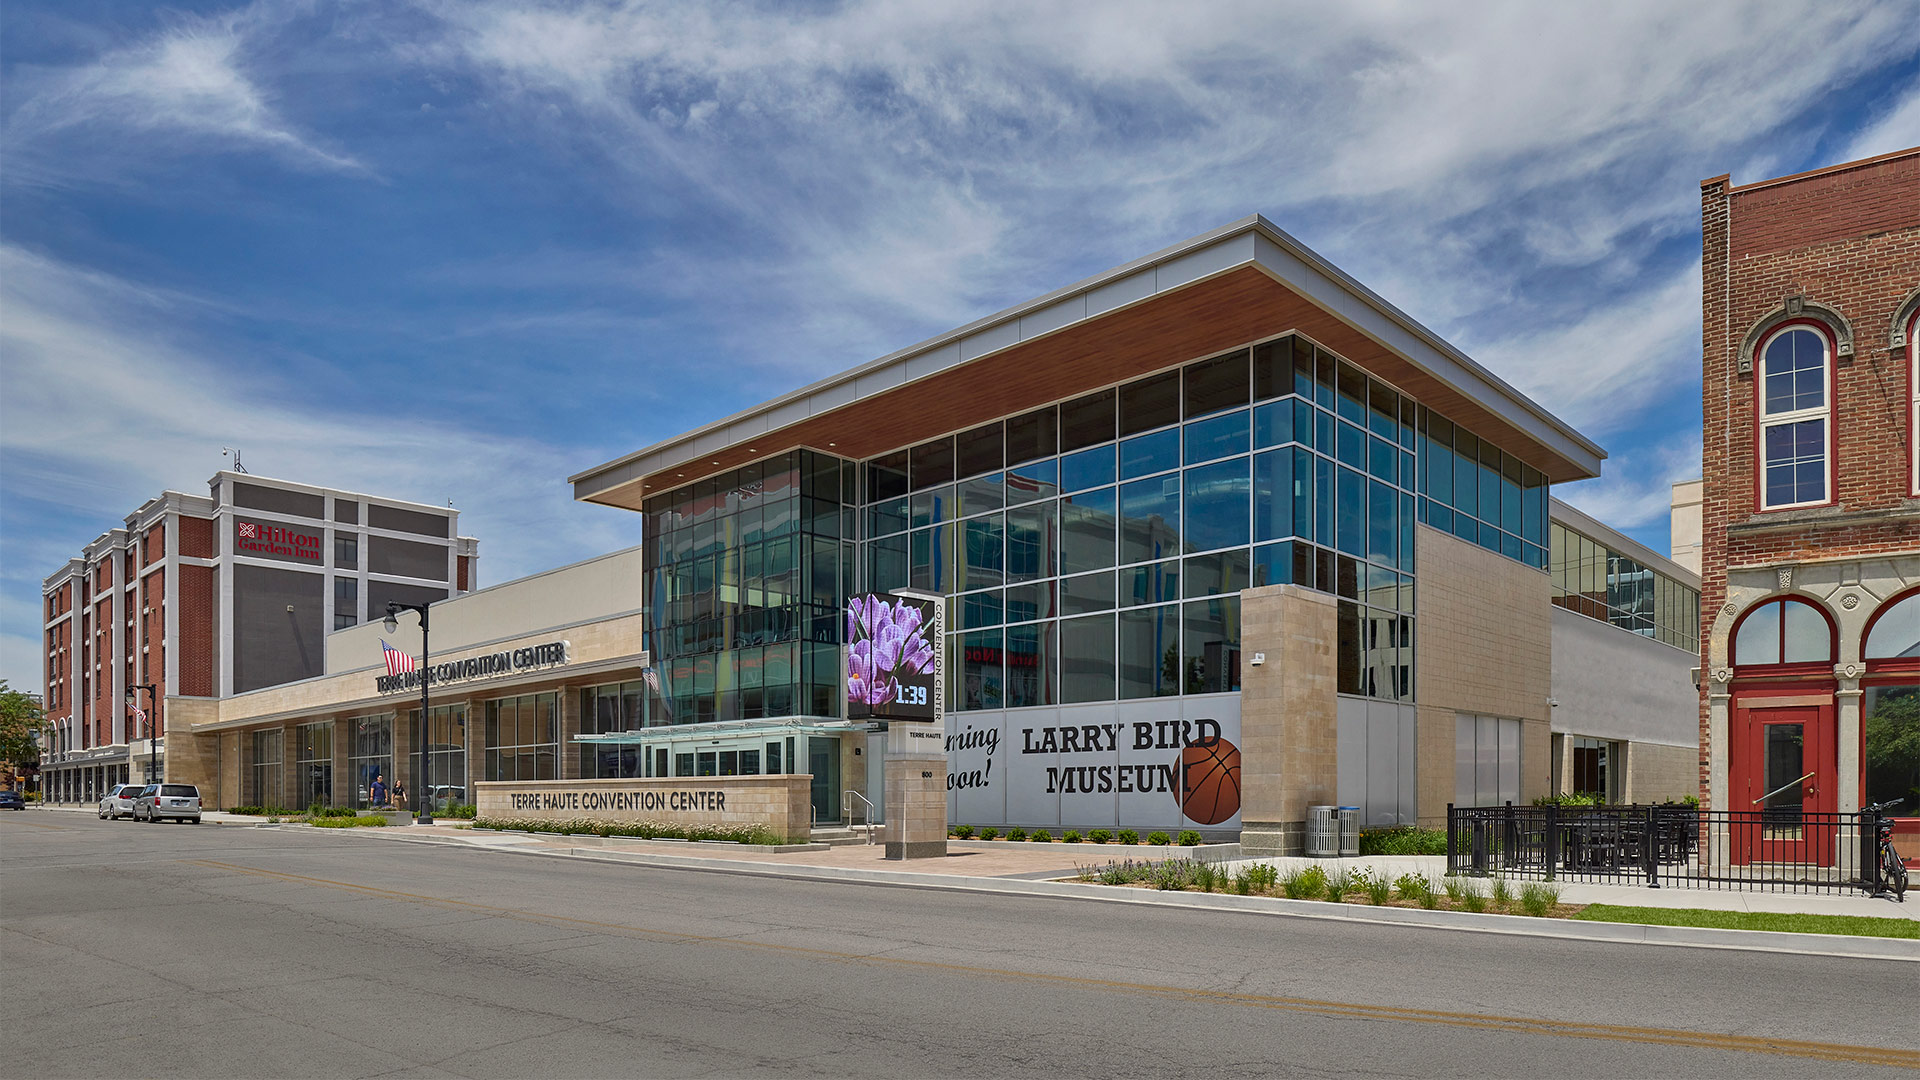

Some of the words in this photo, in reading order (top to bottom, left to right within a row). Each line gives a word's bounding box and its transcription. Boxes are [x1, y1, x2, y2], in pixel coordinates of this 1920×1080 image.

[257, 524, 320, 548] Hilton
[238, 538, 292, 556] Garden
[295, 545, 319, 560] Inn
[375, 671, 404, 692] TERRE
[404, 666, 436, 689] HAUE
[436, 651, 512, 682] CONVENTION
[513, 641, 569, 669] CENTER
[896, 684, 927, 705] 1:39
[1021, 723, 1125, 754] LARRY
[1132, 718, 1221, 750] BIRD
[1046, 764, 1192, 793] MUSEUM
[511, 793, 541, 810] TERRE
[543, 792, 578, 810] HAUTE
[582, 791, 665, 811] CONVENTION
[670, 791, 725, 811] CENTER
